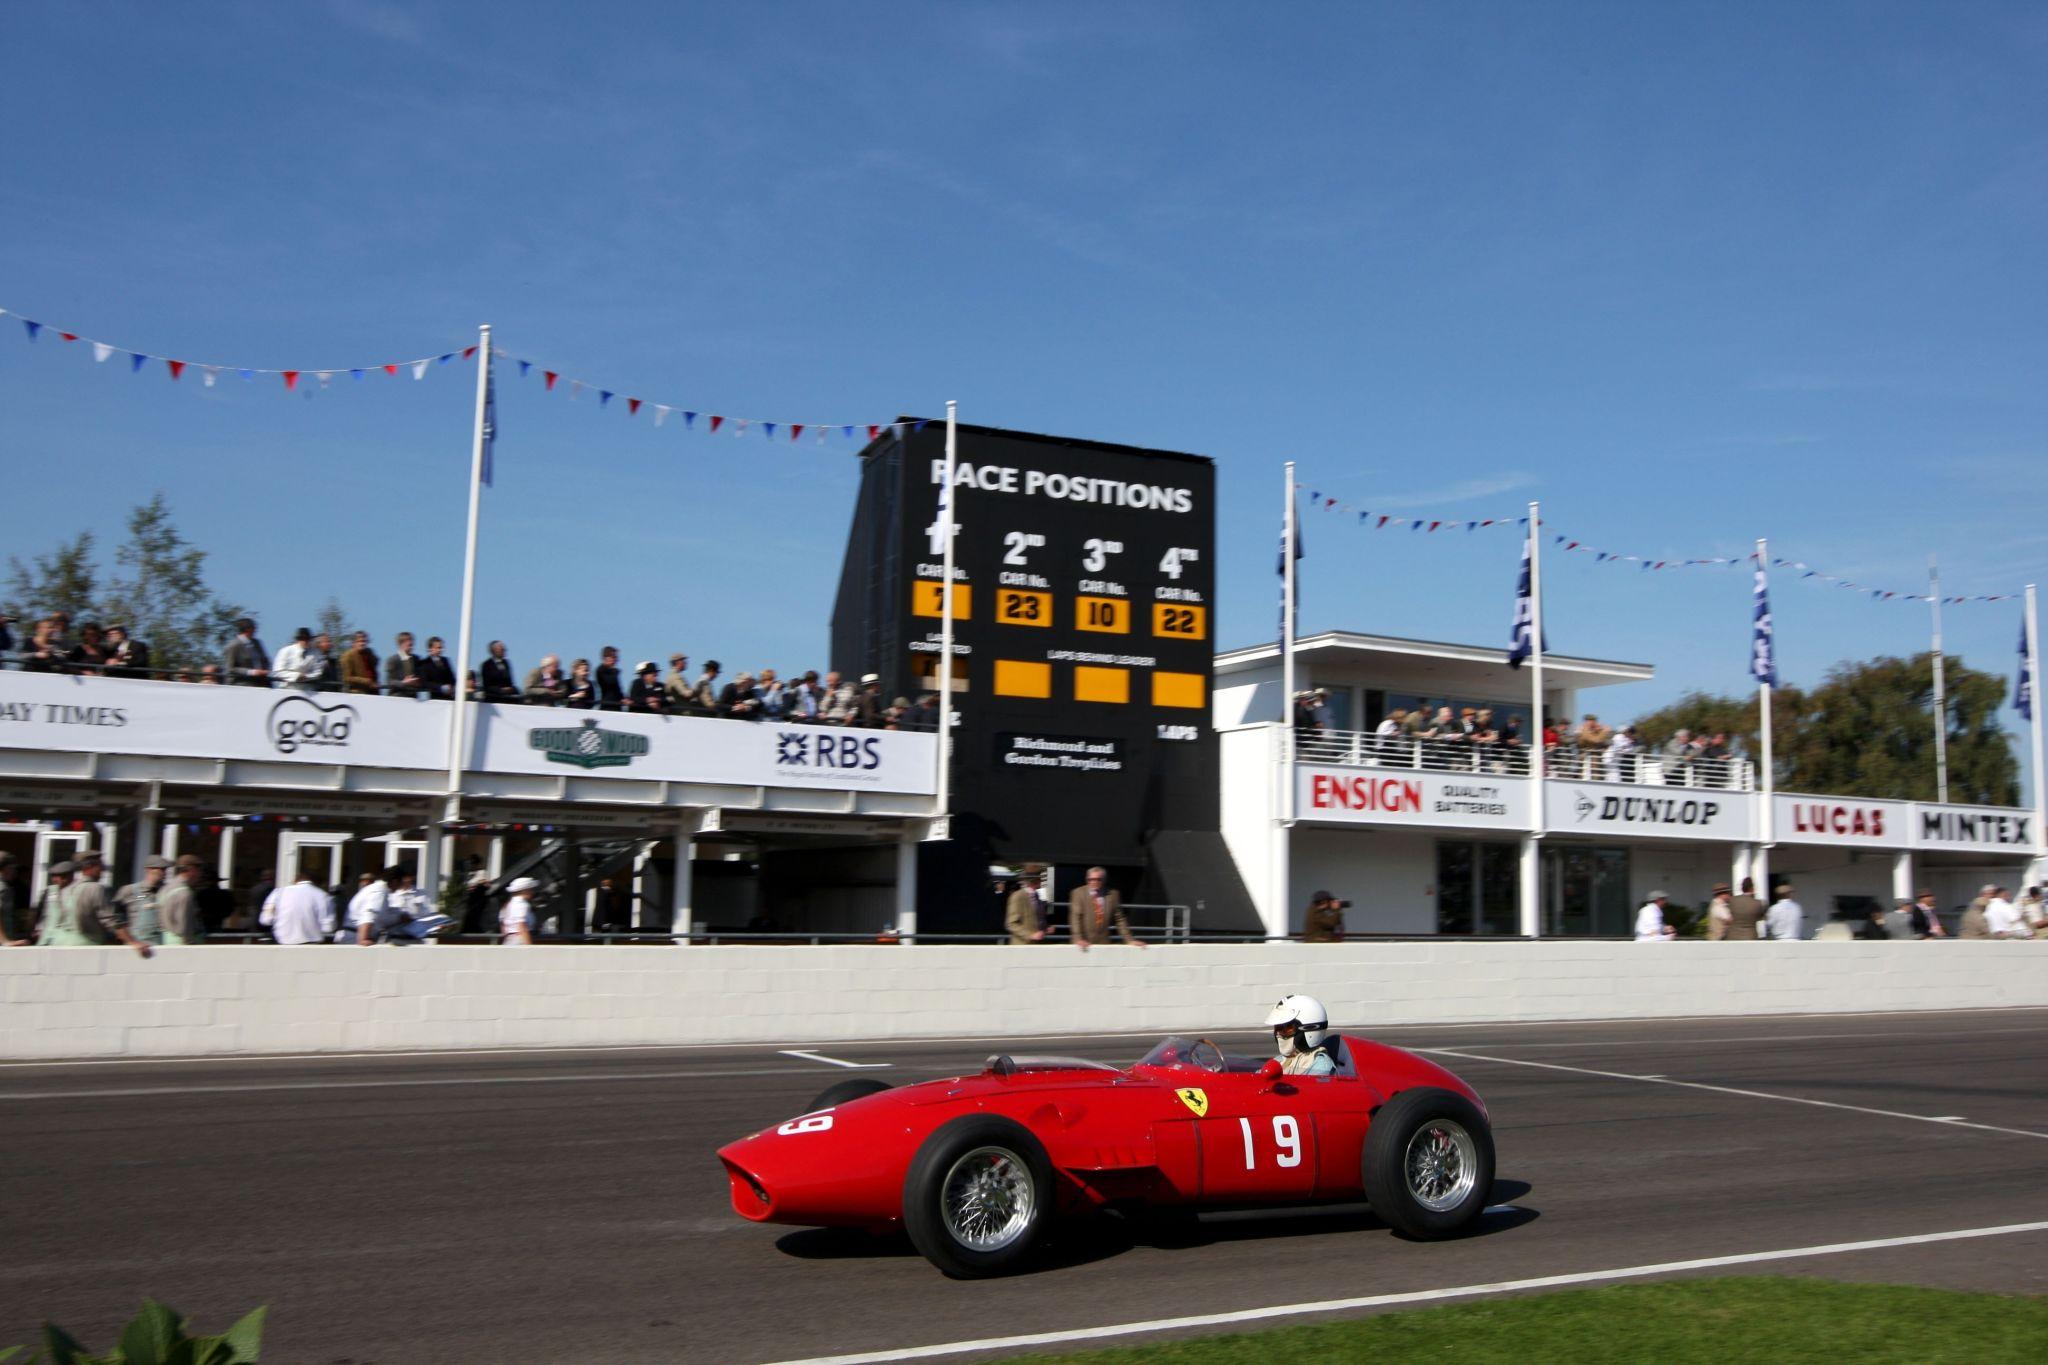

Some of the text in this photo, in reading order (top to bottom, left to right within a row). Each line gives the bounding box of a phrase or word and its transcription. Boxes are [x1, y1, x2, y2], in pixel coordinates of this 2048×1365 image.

[1025, 470, 1193, 513] POSITIONS
[1006, 594, 1040, 620] 23
[1088, 602, 1115, 627] 10
[1163, 609, 1196, 633] 22
[46, 703, 128, 727] TIMES
[275, 714, 350, 754] gold
[1157, 724, 1198, 741] LAPS
[816, 734, 881, 770] RBS
[1312, 775, 1423, 813] ENSIGN
[1441, 784, 1500, 800] QUALITY
[1434, 801, 1507, 815] BATTERIES
[1600, 796, 1721, 826] DUNLOP
[1793, 804, 1886, 837] LUCAS
[1922, 811, 2033, 845] MINTEX
[1239, 1114, 1301, 1170] 19
